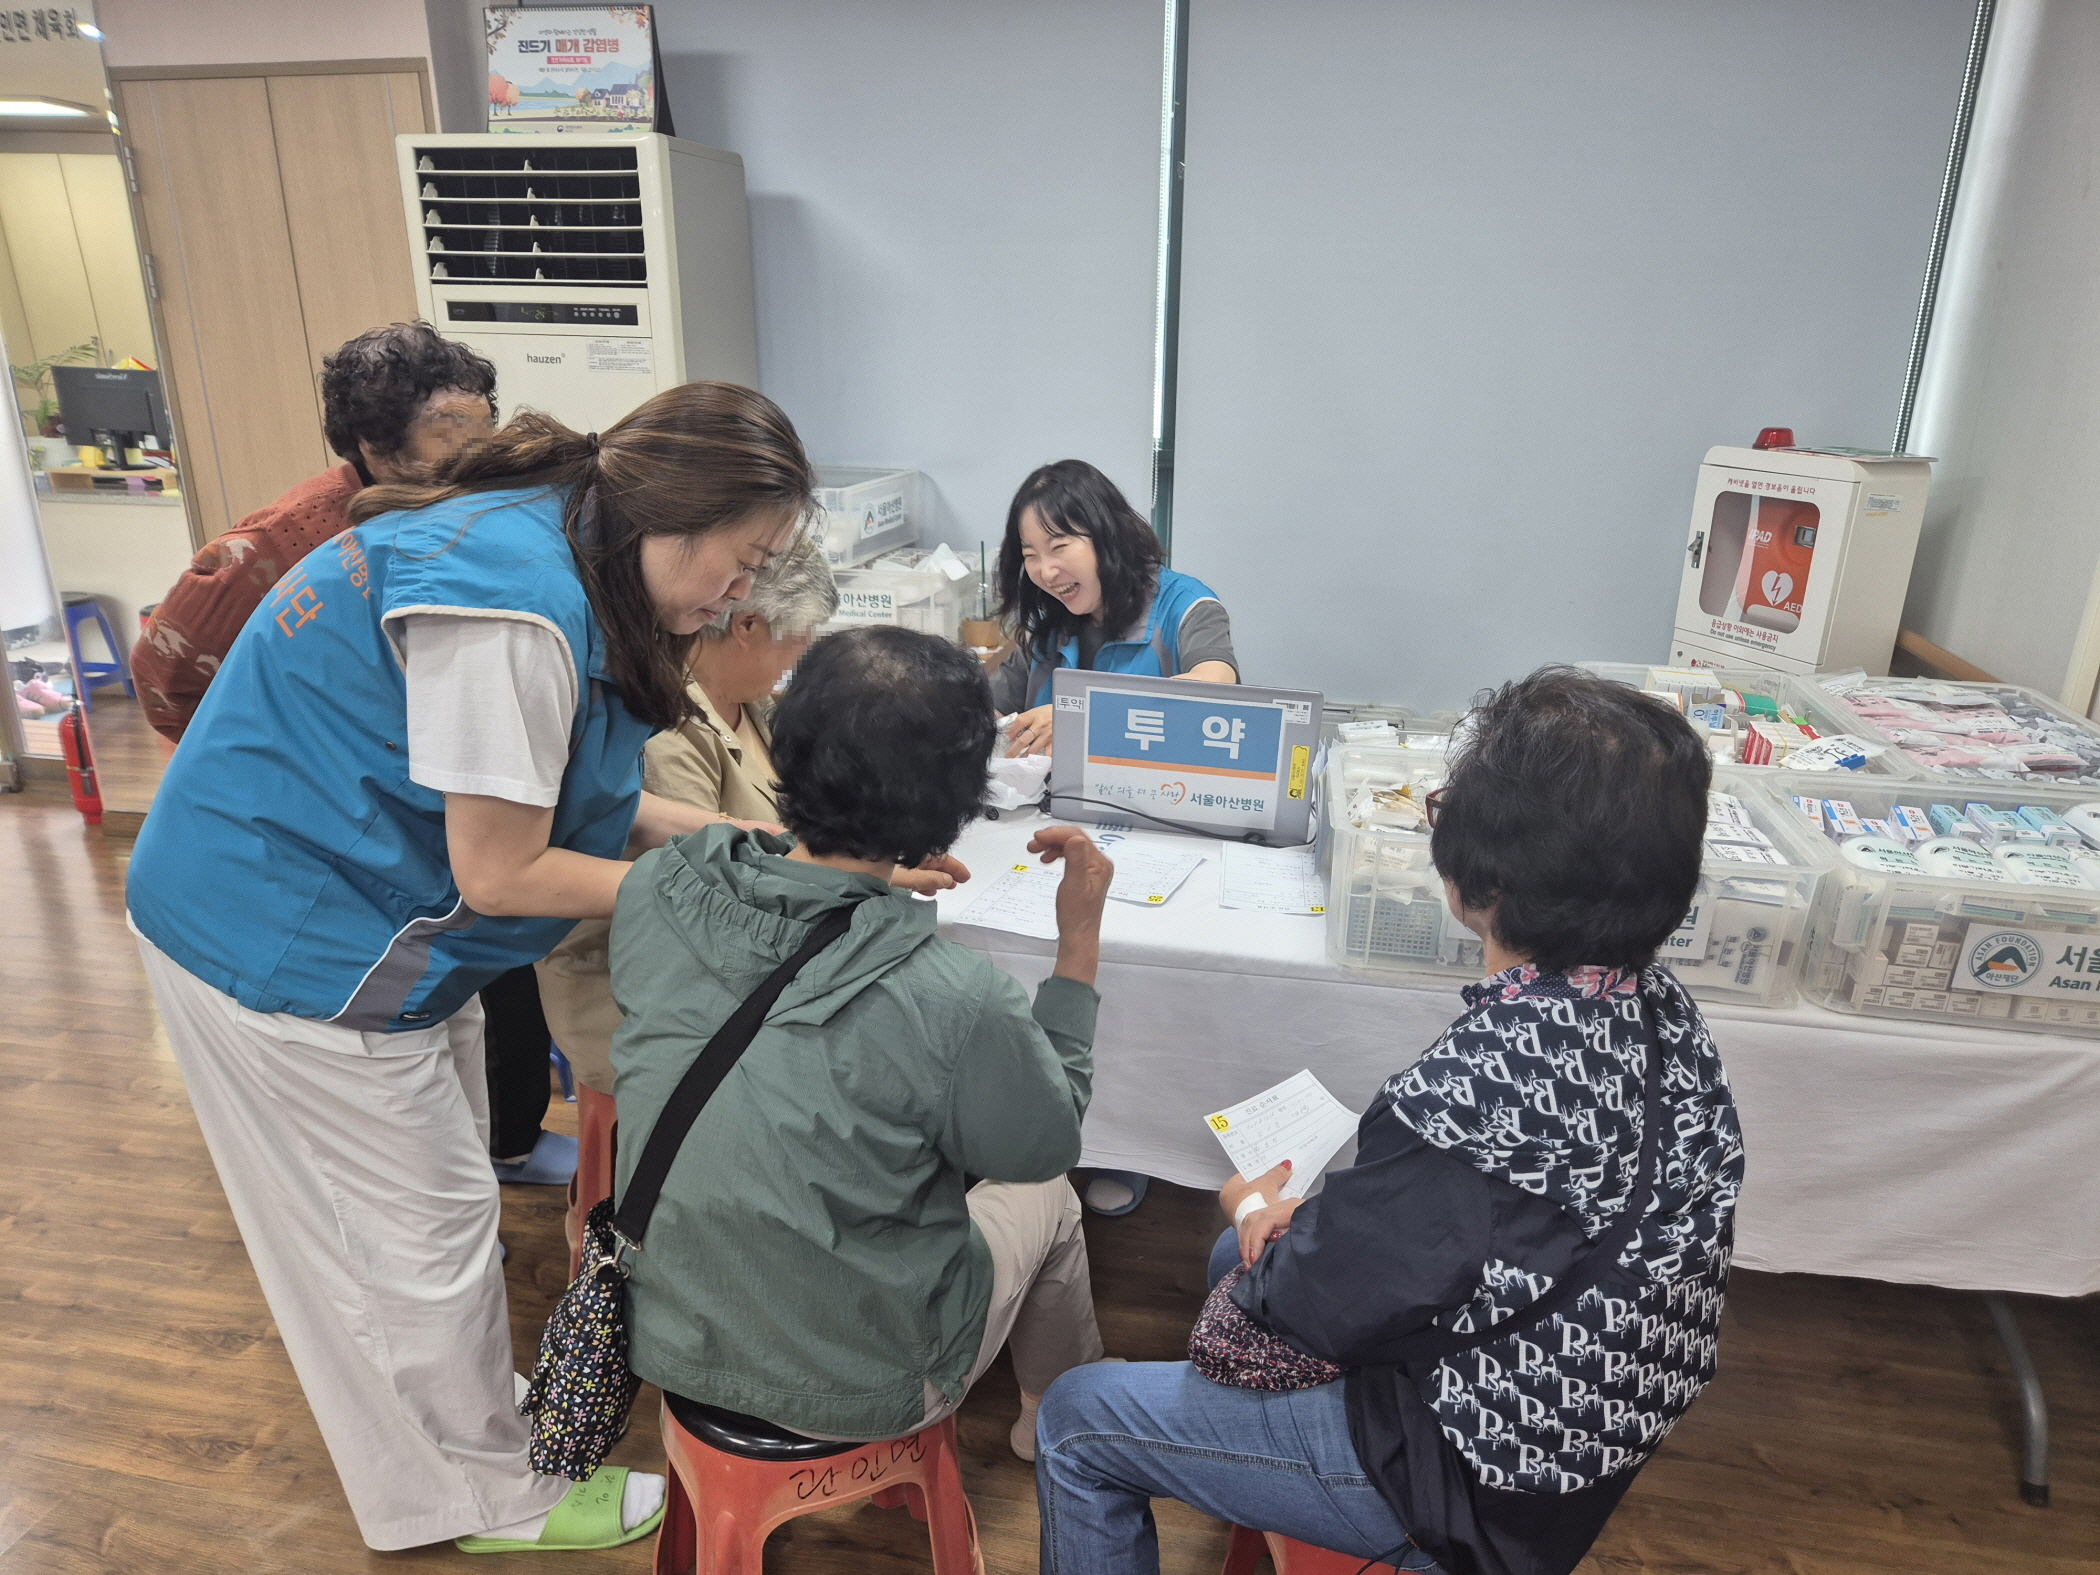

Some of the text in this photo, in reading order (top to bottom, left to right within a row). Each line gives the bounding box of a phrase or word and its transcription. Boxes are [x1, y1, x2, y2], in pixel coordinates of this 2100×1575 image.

[517, 38, 620, 53] 진드기 매개 감염병
[526, 353, 562, 364] hauzen
[1765, 483, 1789, 493] 경보음이
[1790, 485, 1816, 495] 울립니다
[839, 593, 892, 609] 아산병원
[1783, 601, 1803, 614] AED
[868, 611, 892, 619] Center
[1711, 618, 1733, 633] 응급상황
[1756, 627, 1779, 643] 사용금지
[1750, 638, 1777, 651] emergency
[1058, 698, 1084, 710] 투약
[1117, 785, 1134, 799] 의술
[1137, 788, 1147, 796] 더
[1150, 789, 1157, 800] 큰
[1160, 788, 1180, 803] 사랑
[1190, 792, 1265, 812] 서울아산병원
[1013, 864, 1028, 872] 17
[1662, 936, 1693, 948] ter
[1975, 939, 1993, 961] ASAN
[1995, 935, 2037, 967] FOUNDATION
[1985, 972, 2019, 983] 아산재단
[2048, 975, 2092, 991] Asan
[1210, 1115, 1229, 1130] 15
